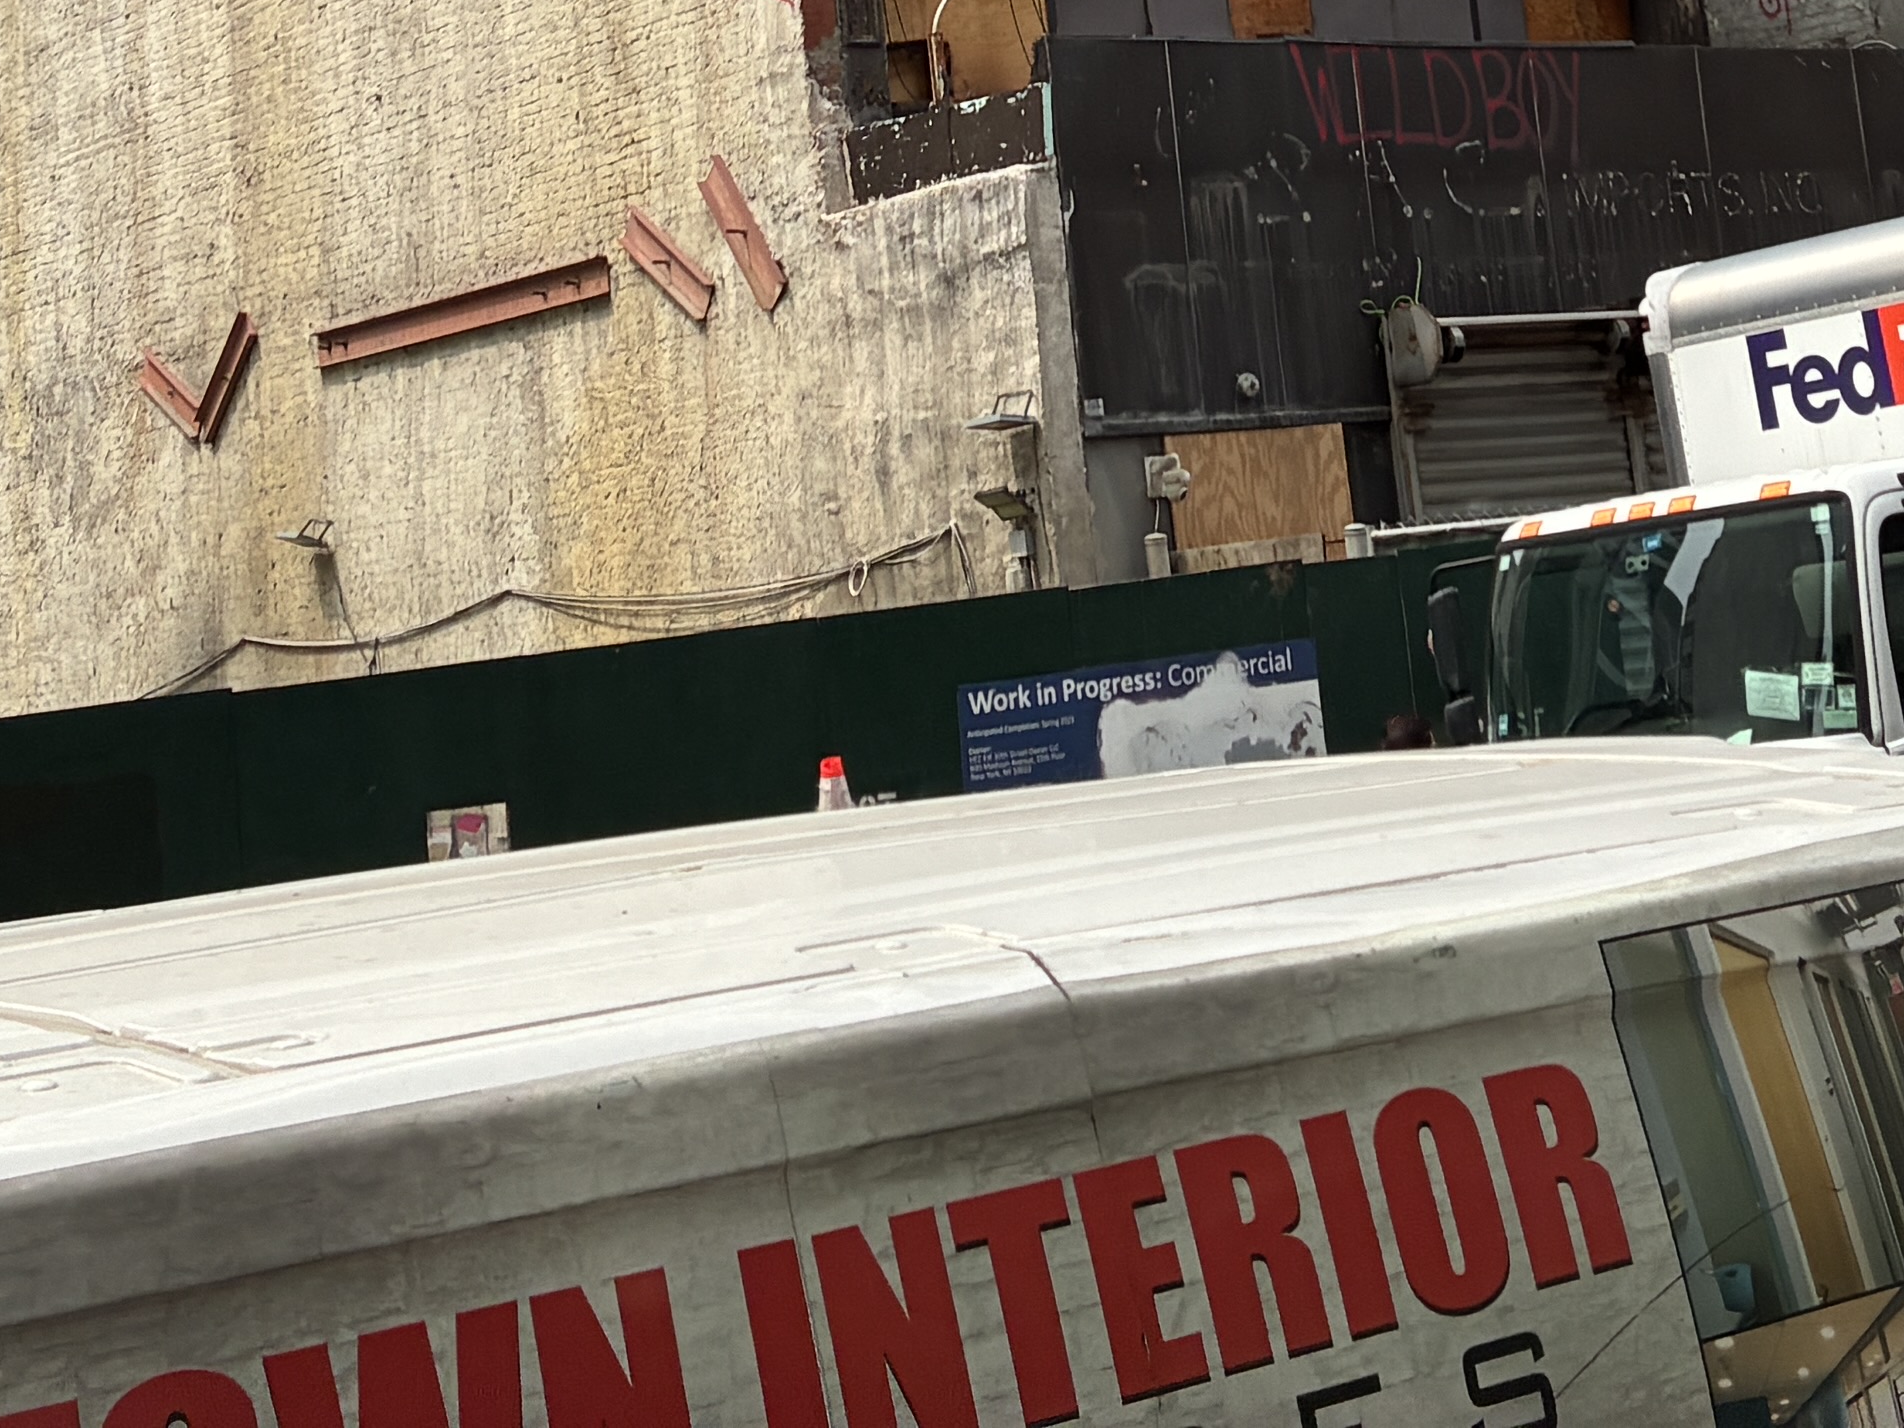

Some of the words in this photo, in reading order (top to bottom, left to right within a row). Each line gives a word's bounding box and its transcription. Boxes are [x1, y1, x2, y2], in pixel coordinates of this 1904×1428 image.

[968, 685, 1032, 716] Work
[1036, 681, 1058, 706] in
[1061, 670, 1163, 703] Progress:
[1167, 645, 1293, 687] Comercial
[737, 1062, 1634, 1427] INTERIOR
